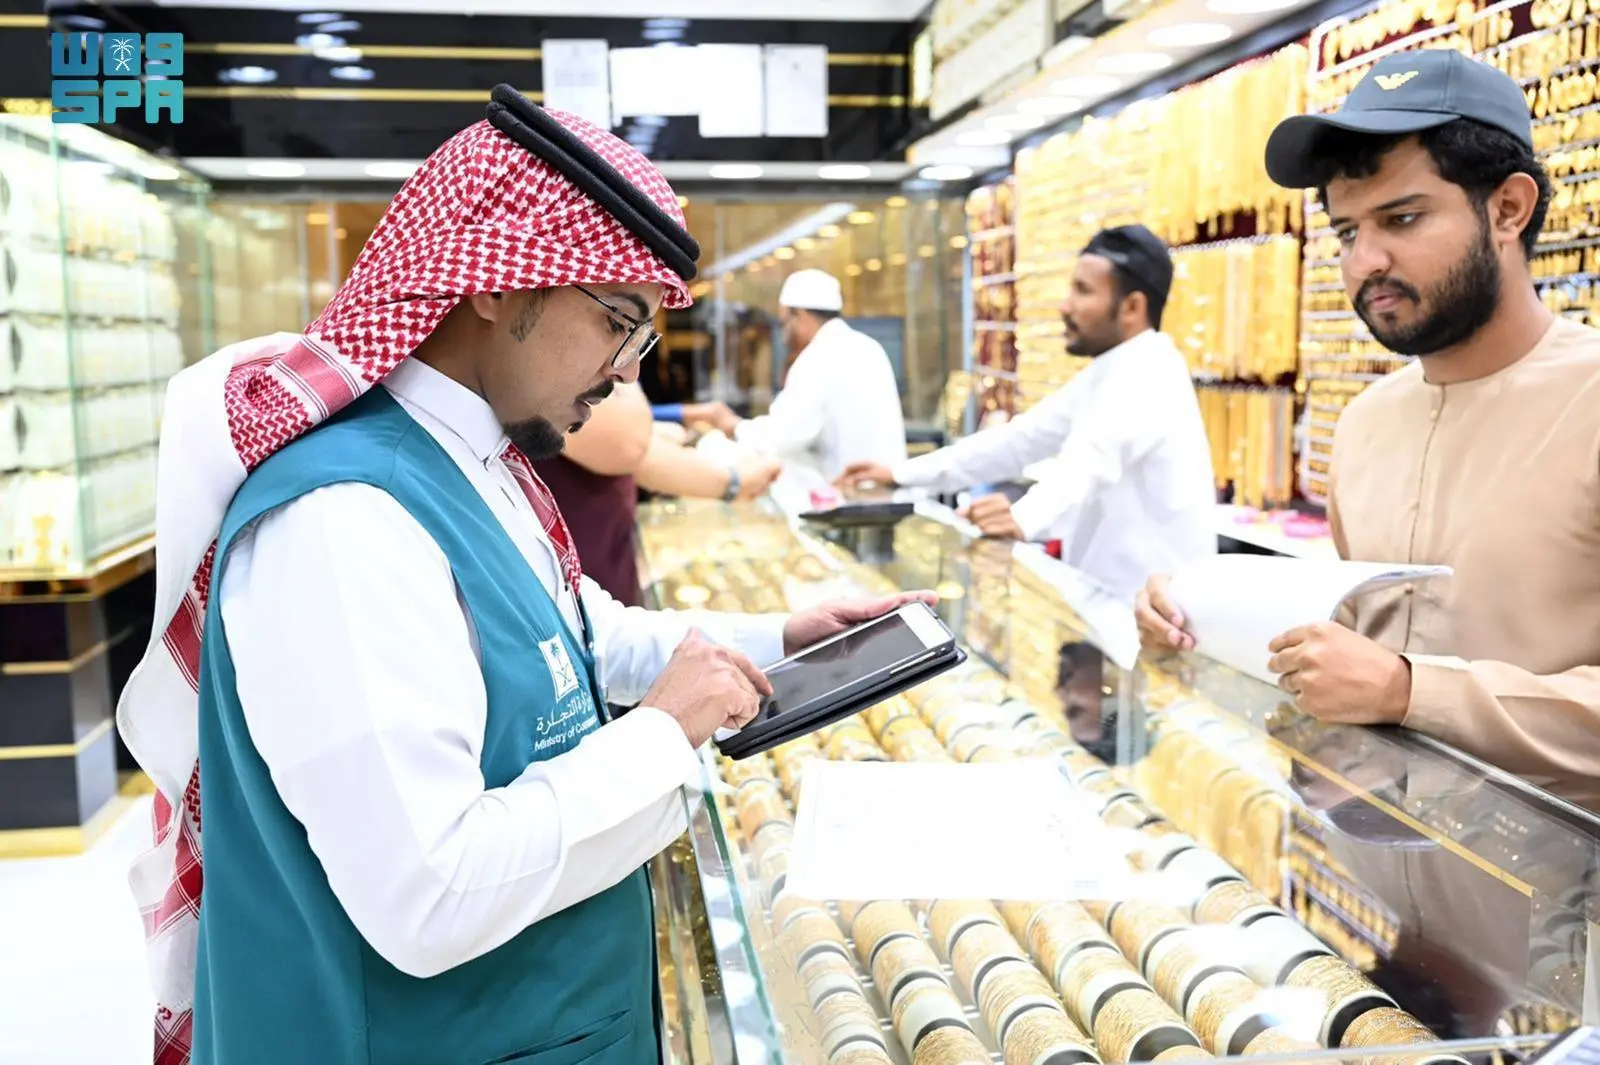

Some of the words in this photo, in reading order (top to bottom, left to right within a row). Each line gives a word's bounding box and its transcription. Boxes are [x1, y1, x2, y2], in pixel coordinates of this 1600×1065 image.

[535, 696, 578, 735] التجارة
[534, 732, 566, 751] Ministry
[567, 725, 575, 738] of
